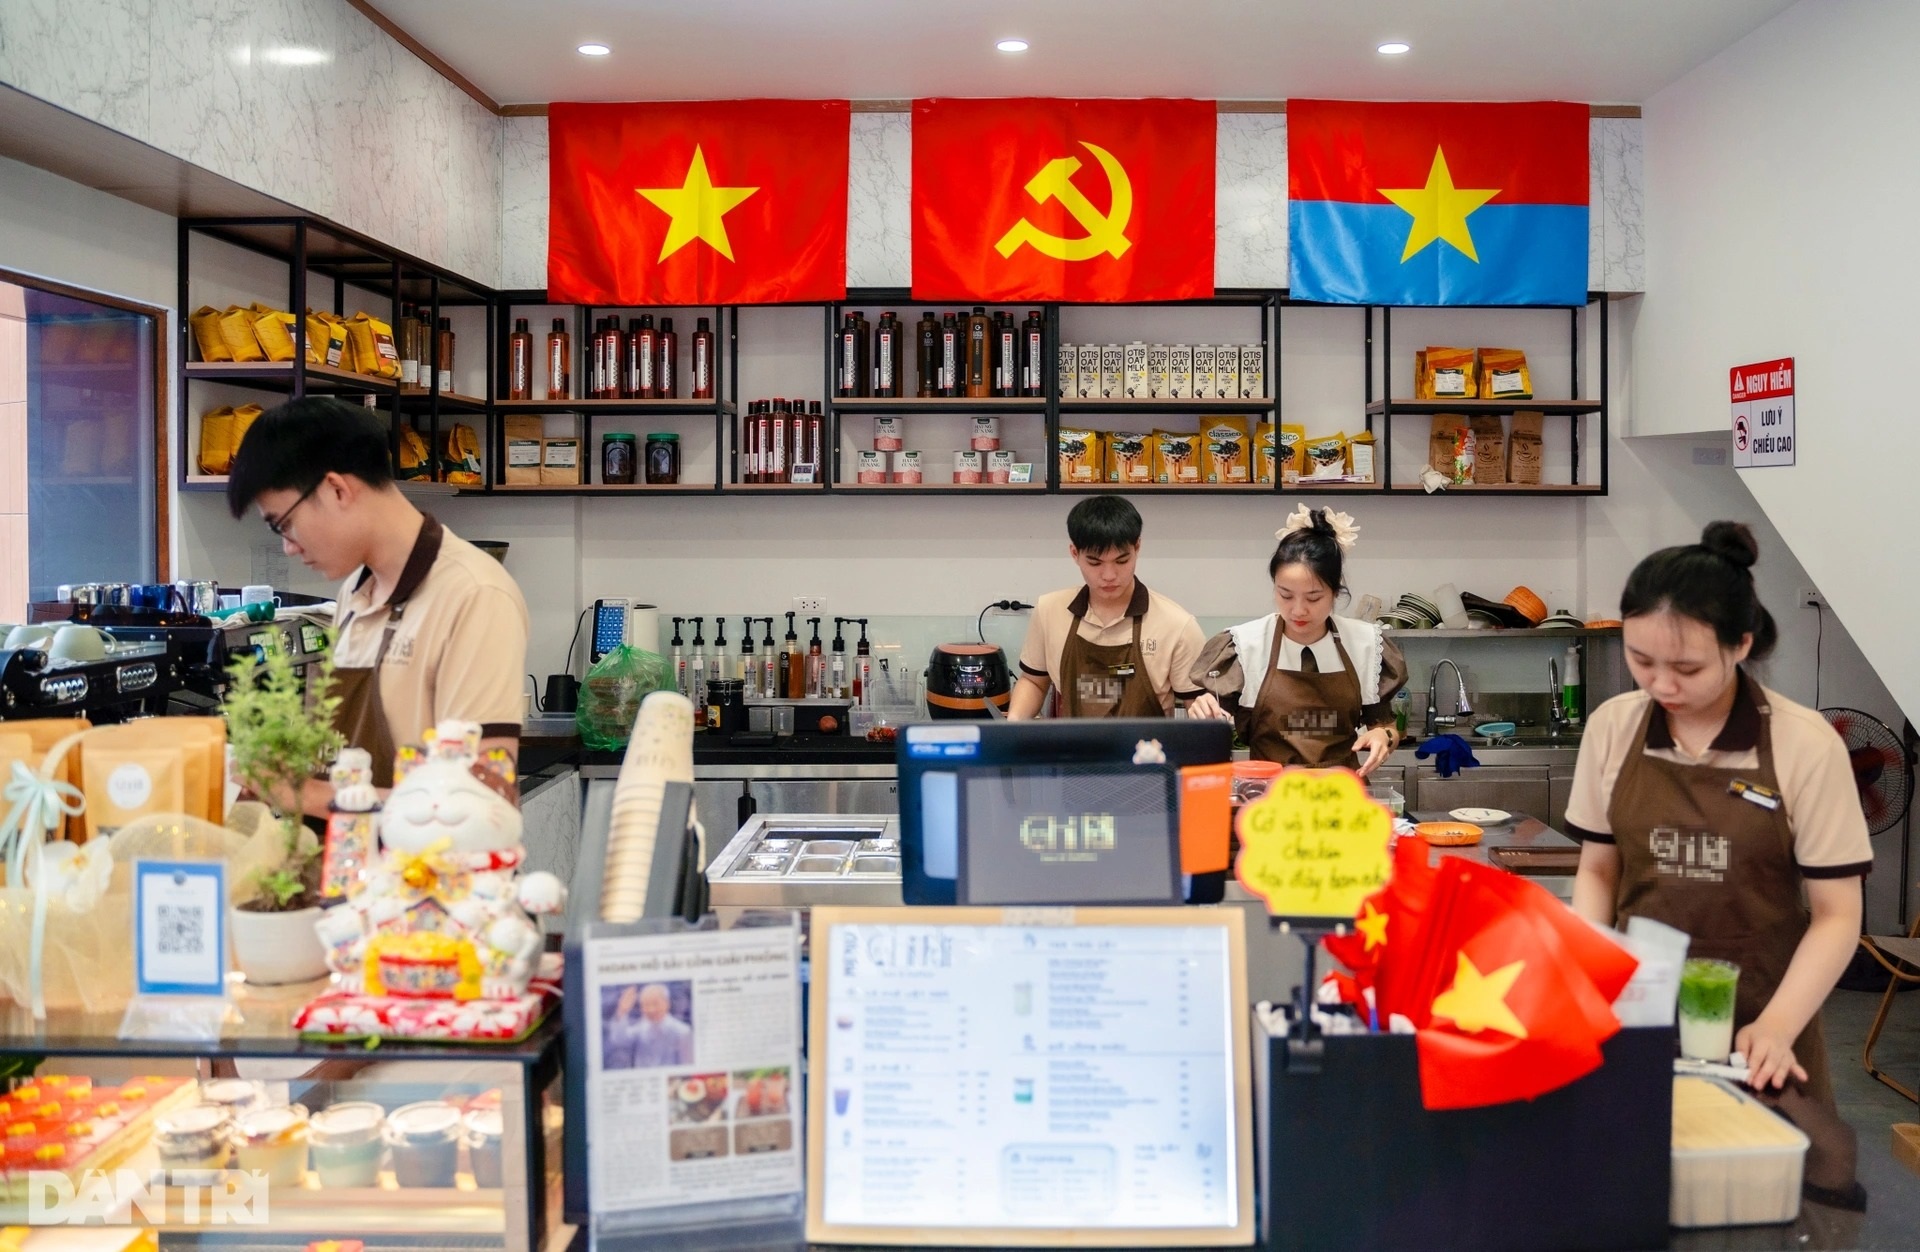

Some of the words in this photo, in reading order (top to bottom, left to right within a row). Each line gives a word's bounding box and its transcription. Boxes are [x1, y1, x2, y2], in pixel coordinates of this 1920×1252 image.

[1746, 373, 1768, 394] NGUY
[1770, 362, 1792, 391] HIỂM
[1761, 409, 1776, 427] LƯU
[1777, 436, 1792, 452] CAO
